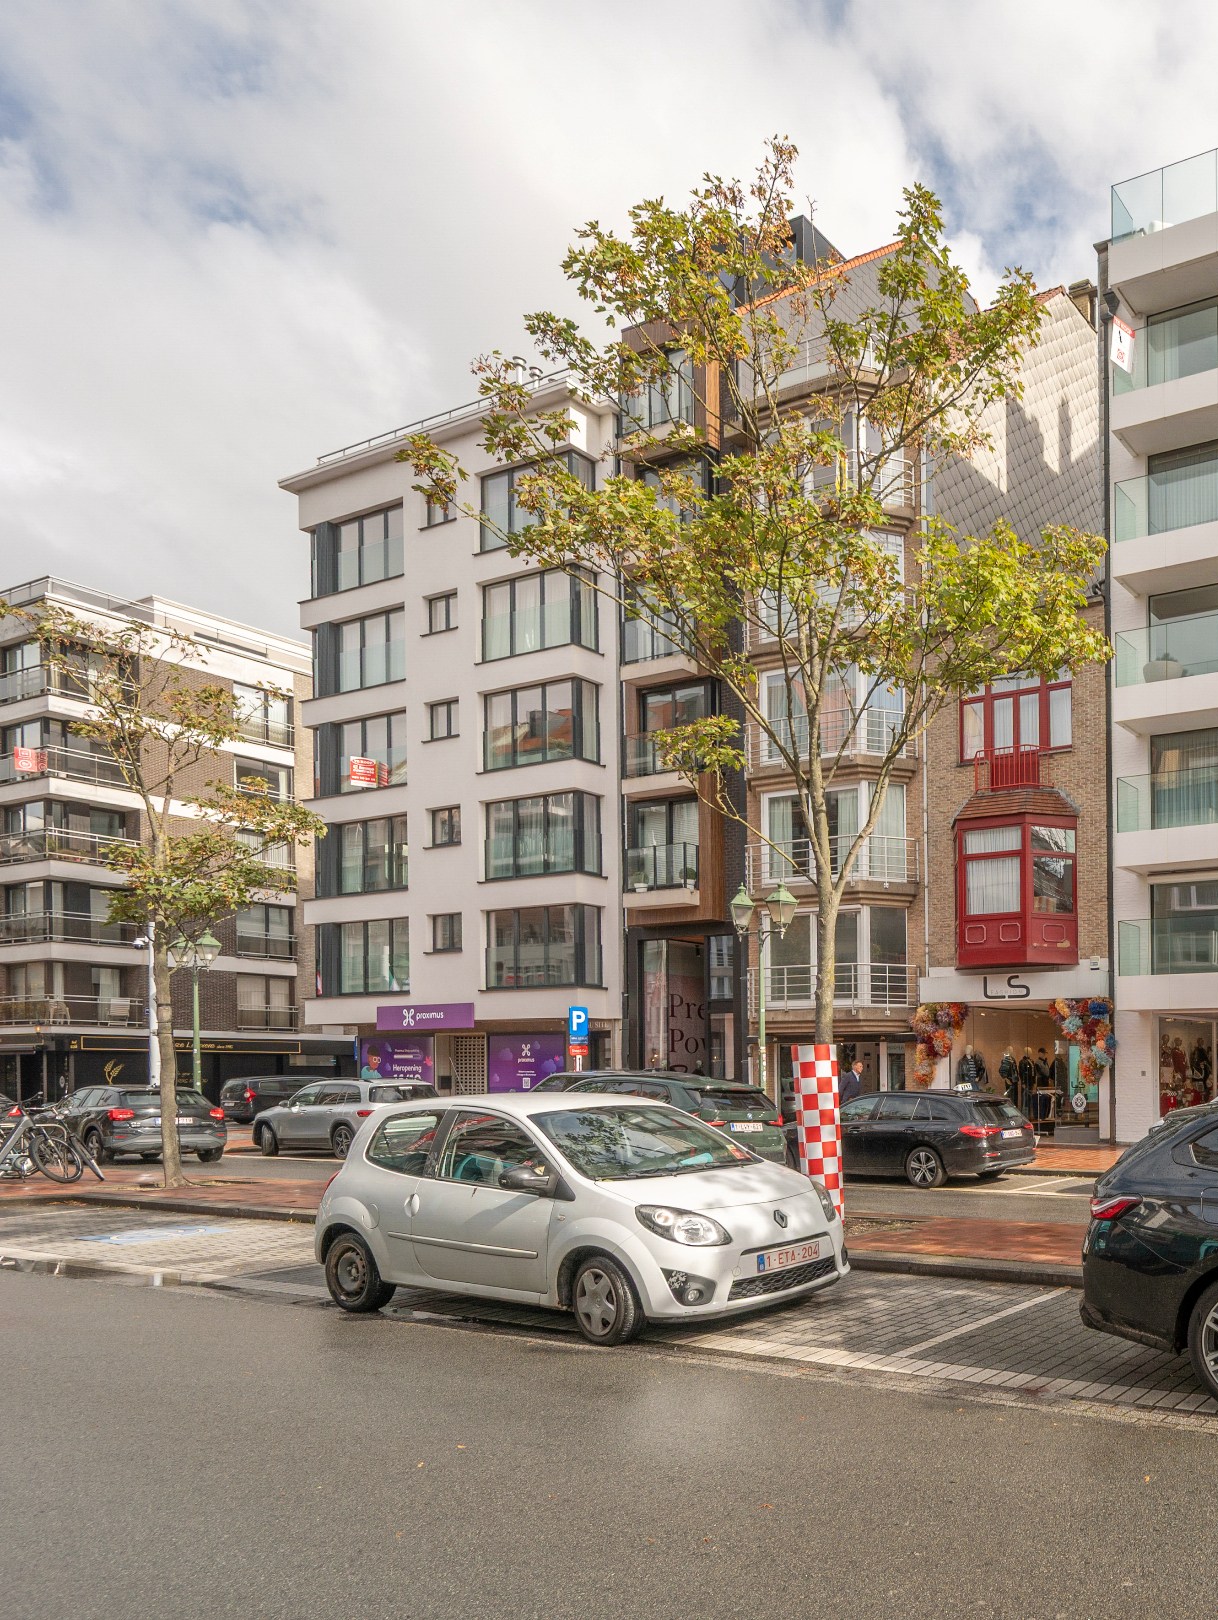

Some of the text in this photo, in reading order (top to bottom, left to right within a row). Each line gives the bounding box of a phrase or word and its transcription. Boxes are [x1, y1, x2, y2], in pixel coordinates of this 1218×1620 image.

[983, 975, 1030, 999] LS
[416, 1011, 444, 1021] proximus
[572, 1010, 586, 1031] P
[392, 1064, 422, 1073] Heropening
[767, 1243, 818, 1268] 1-ETA-204
